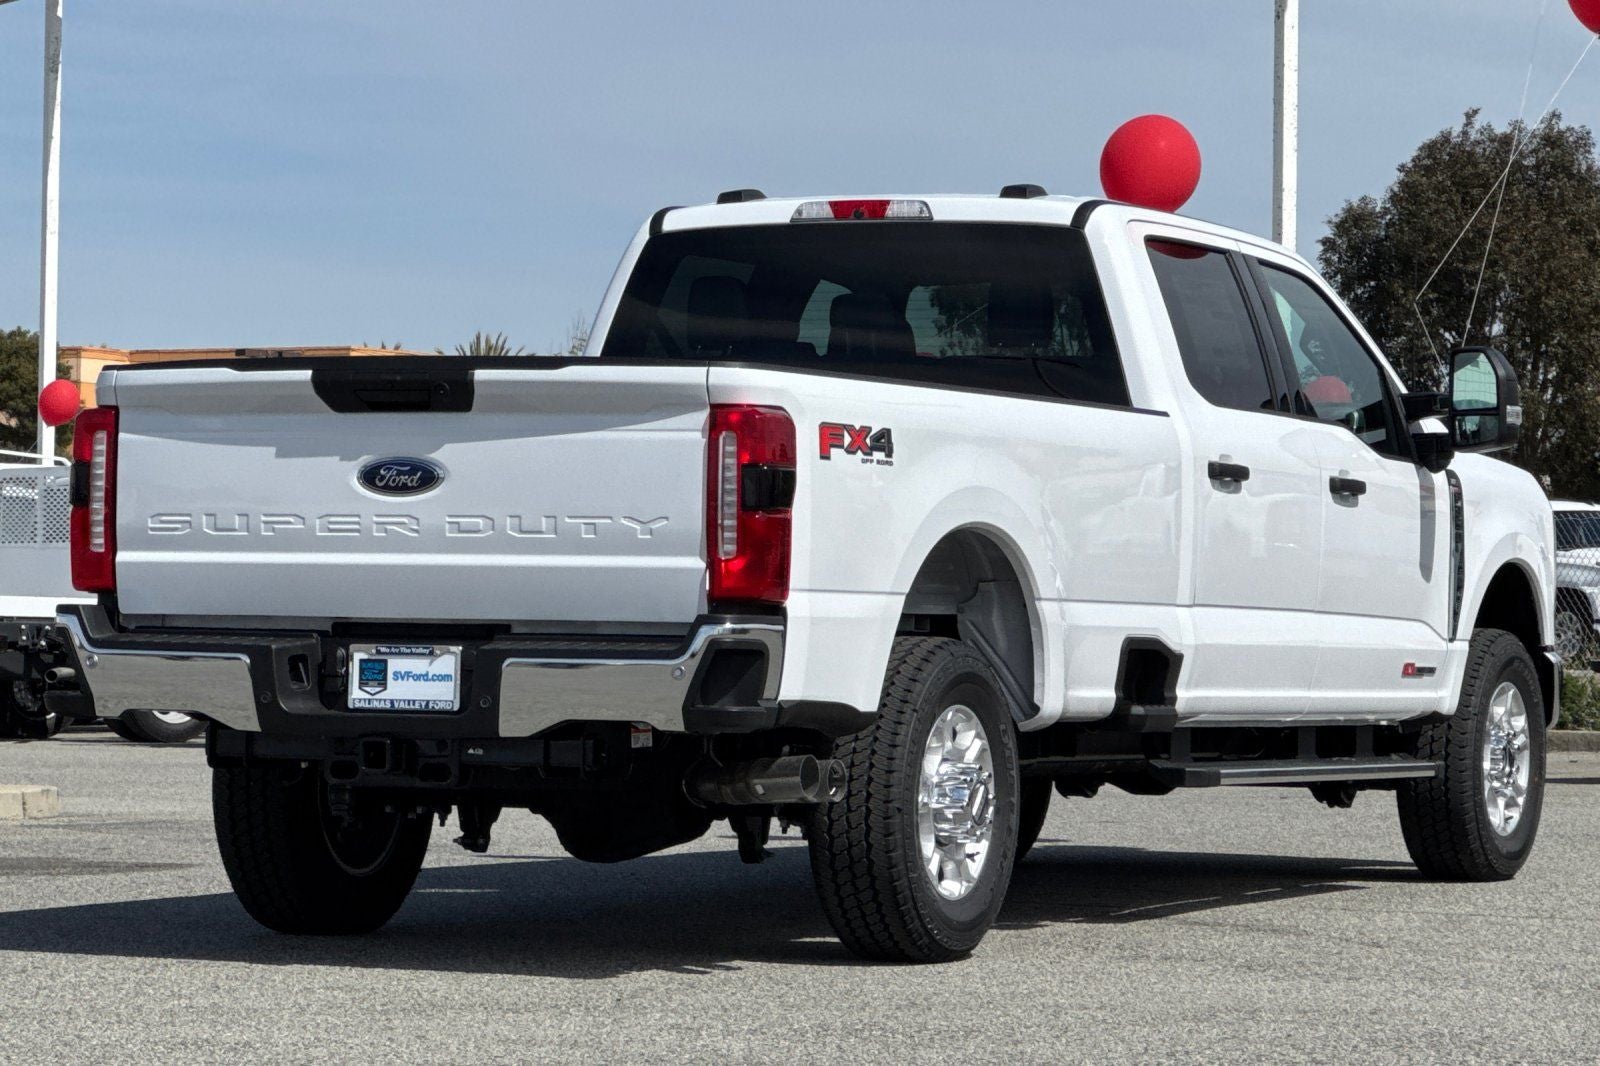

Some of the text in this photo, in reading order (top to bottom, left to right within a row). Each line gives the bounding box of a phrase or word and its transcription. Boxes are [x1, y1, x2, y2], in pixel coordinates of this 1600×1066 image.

[818, 421, 894, 461] FX4
[375, 465, 422, 487] Ford
[147, 512, 669, 538] SUPER DUTY
[362, 669, 384, 680] Ford
[392, 670, 453, 682] SVFord.com
[354, 699, 453, 710] SALINAS VALLEY FORD
